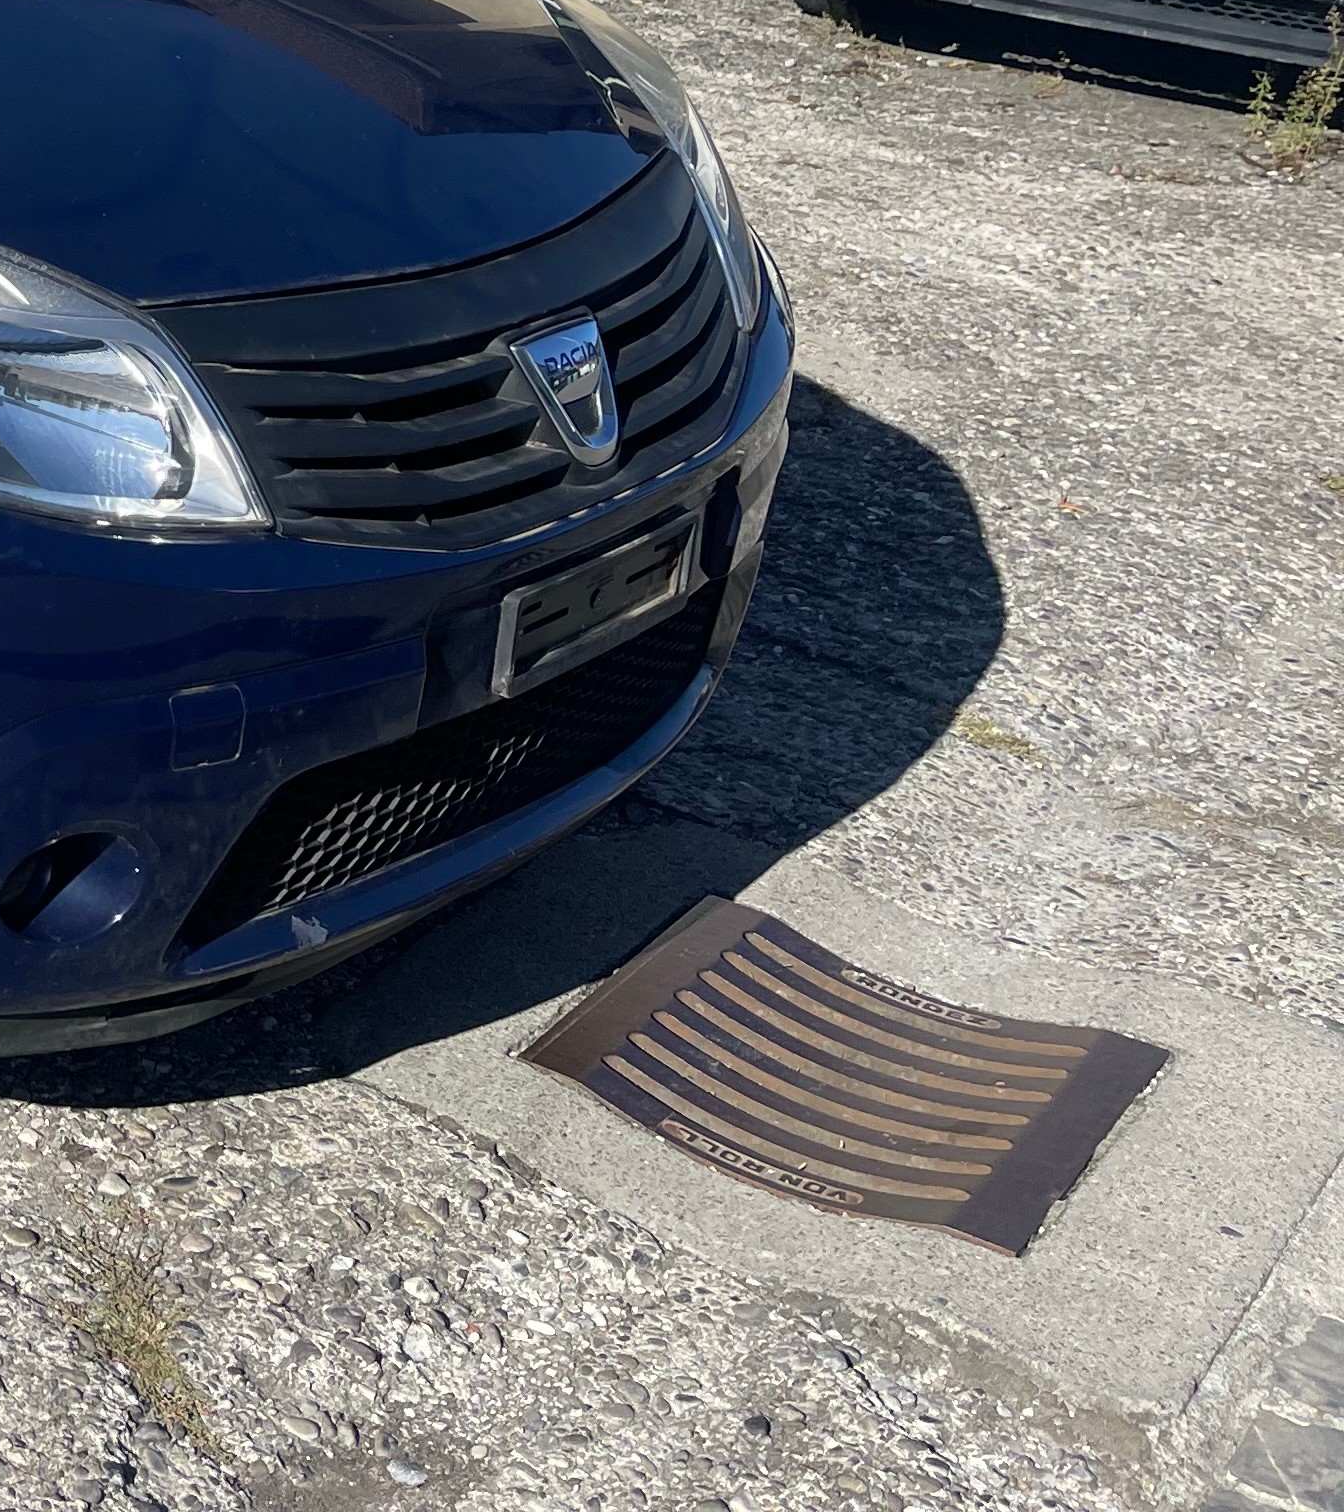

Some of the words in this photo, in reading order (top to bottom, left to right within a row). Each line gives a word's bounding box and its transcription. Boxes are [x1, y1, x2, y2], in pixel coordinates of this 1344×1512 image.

[543, 341, 599, 374] DACIA
[856, 976, 989, 1025] RONDEZ
[678, 1127, 765, 1173] ROLL
[778, 1173, 848, 1203] VON
